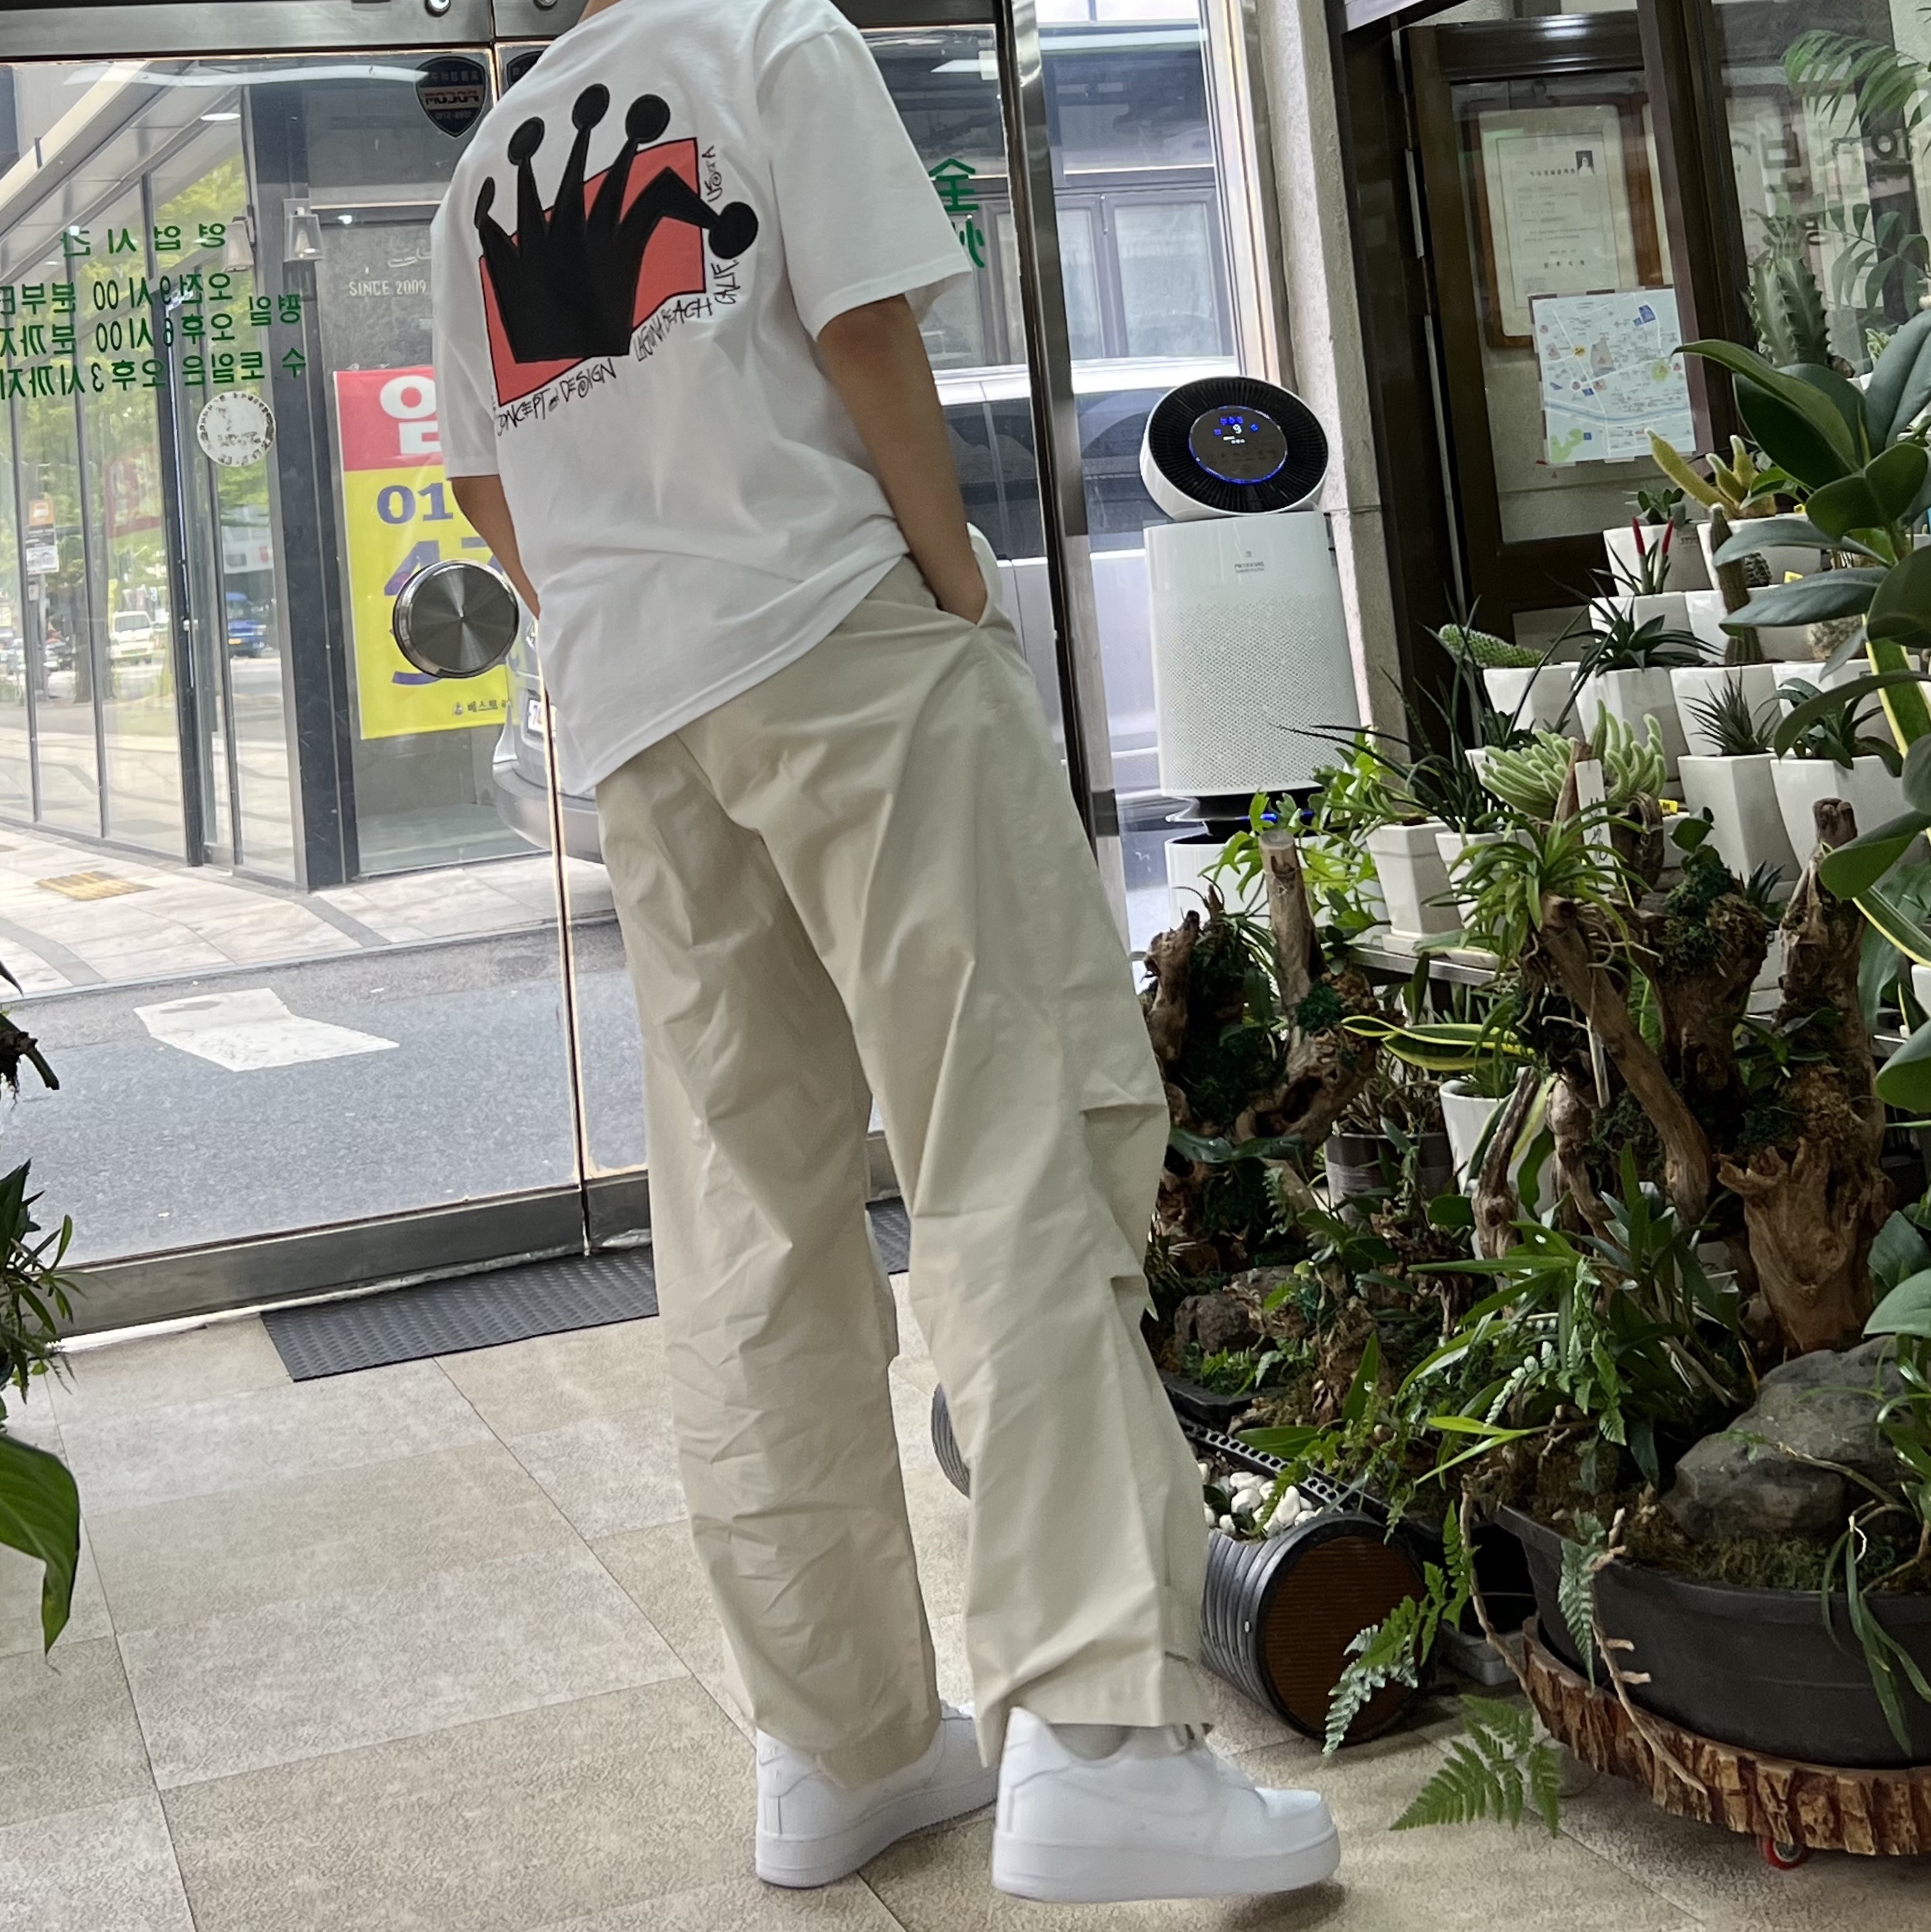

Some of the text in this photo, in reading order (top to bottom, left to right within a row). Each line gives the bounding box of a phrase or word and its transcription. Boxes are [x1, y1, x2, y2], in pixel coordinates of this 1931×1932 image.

[349, 279, 426, 296] SINCE 2009
[560, 358, 617, 403] DESIGN
